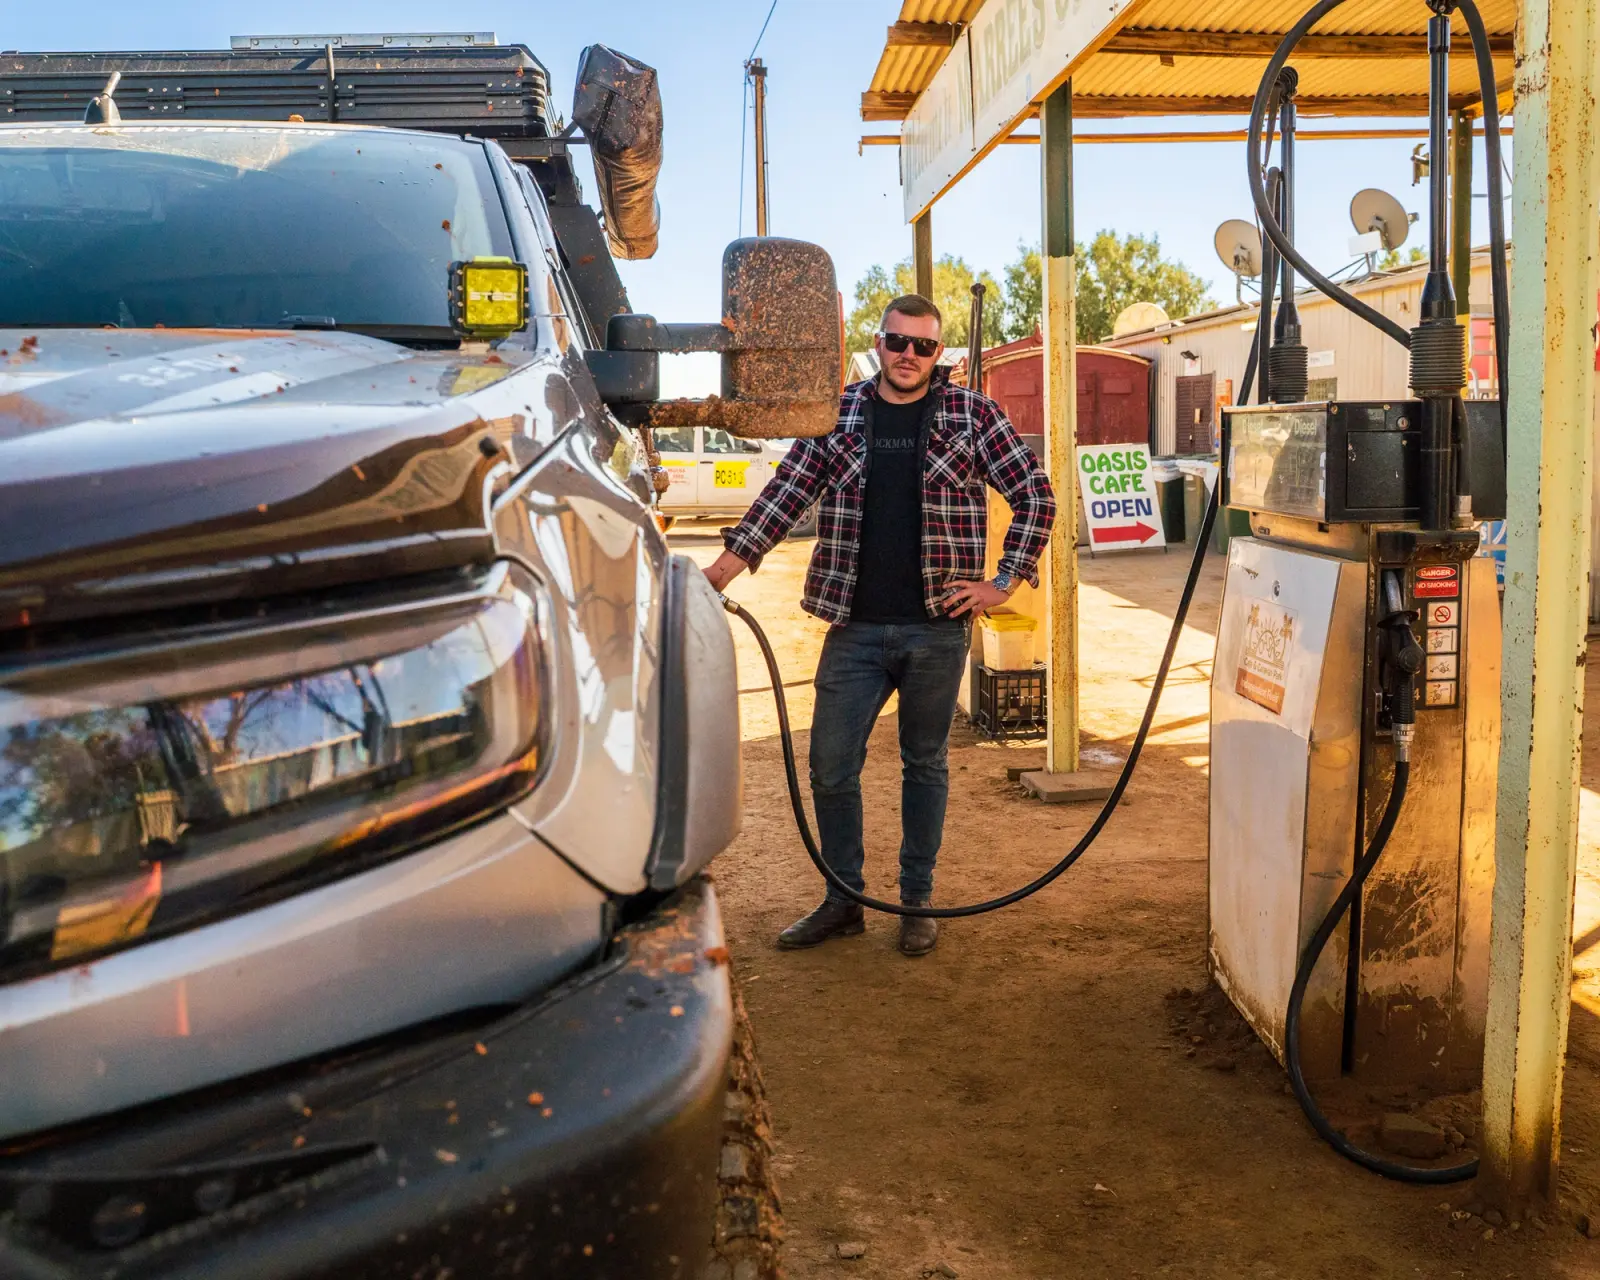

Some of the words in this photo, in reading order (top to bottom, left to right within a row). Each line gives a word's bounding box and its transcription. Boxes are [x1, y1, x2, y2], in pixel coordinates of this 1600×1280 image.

[1294, 418, 1317, 437] Diesel
[1081, 450, 1148, 474] OASIS
[1089, 473, 1147, 495] CAFE
[1091, 497, 1153, 519] OPEN
[1420, 569, 1451, 577] DANGER
[1427, 581, 1457, 589] SMOKING
